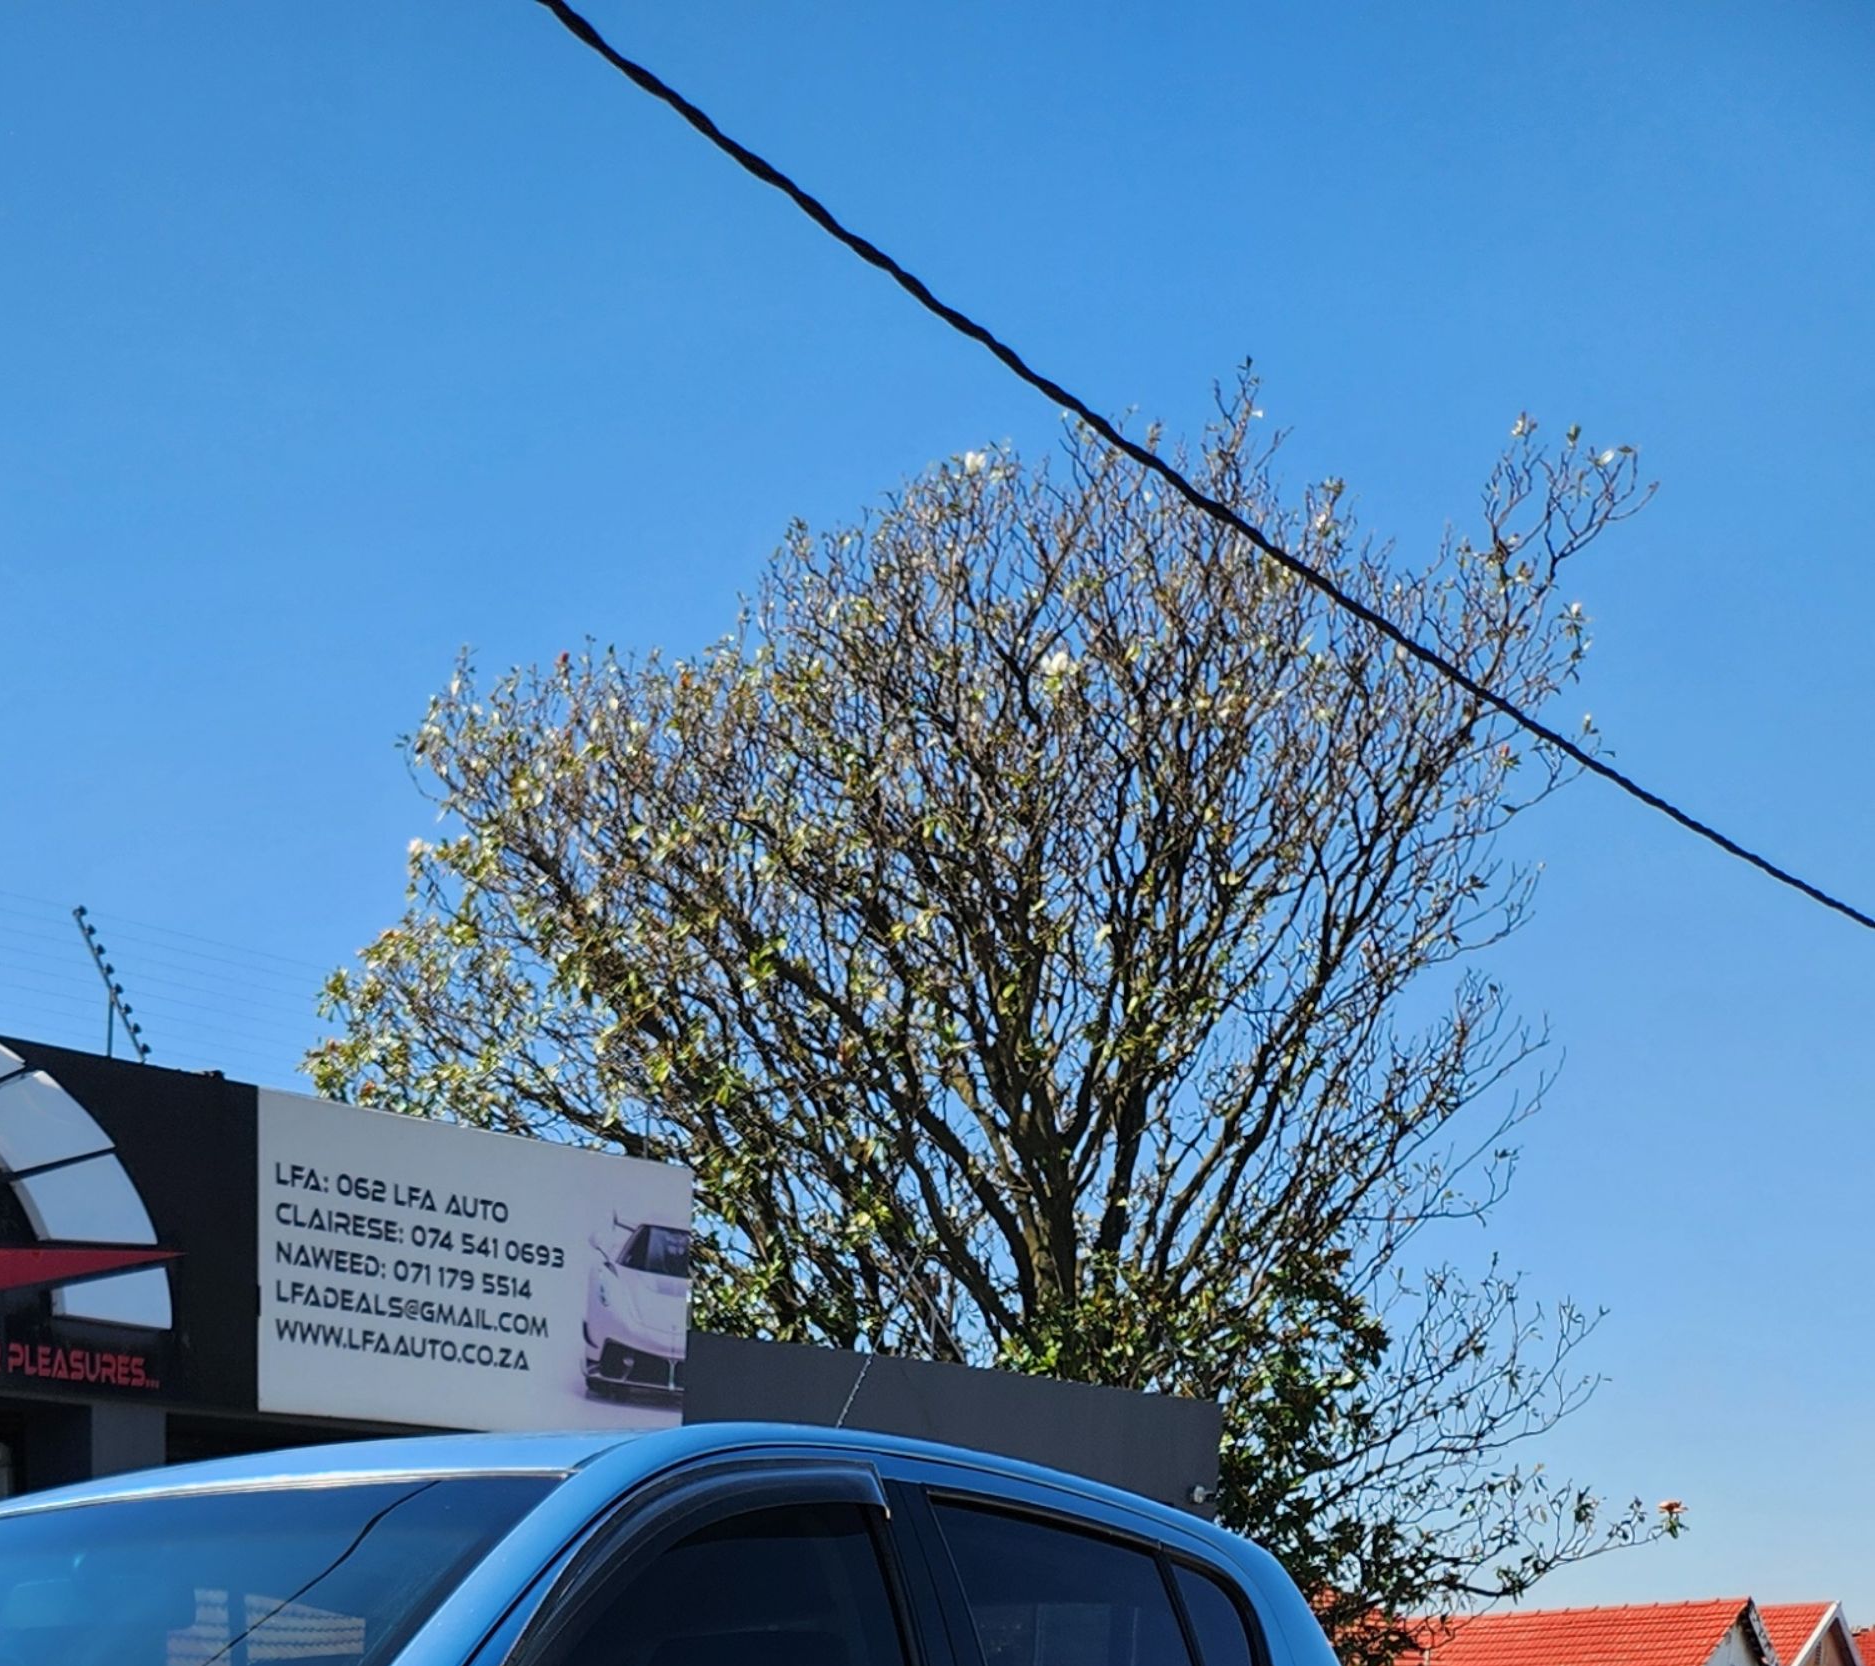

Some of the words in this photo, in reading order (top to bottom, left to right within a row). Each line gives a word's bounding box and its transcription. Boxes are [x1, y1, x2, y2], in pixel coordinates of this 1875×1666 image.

[275, 1162, 330, 1194] LFA:
[337, 1174, 387, 1202] 062
[393, 1186, 437, 1213] LFA
[445, 1194, 508, 1224] AUTO
[275, 1203, 405, 1245] CLAIRESE:
[411, 1225, 453, 1253] 074
[462, 1233, 499, 1260] 541
[505, 1242, 565, 1269] 0693
[275, 1242, 387, 1280] NAWEED:
[393, 1260, 431, 1287] 071
[438, 1267, 474, 1292] 179
[482, 1274, 533, 1300] 5514
[276, 1280, 549, 1339] LFADEALS@GMAIL.COM
[7, 1343, 161, 1390] PLEASURES...
[275, 1319, 530, 1372] WWW.LFAAUTO.CO.ZA
